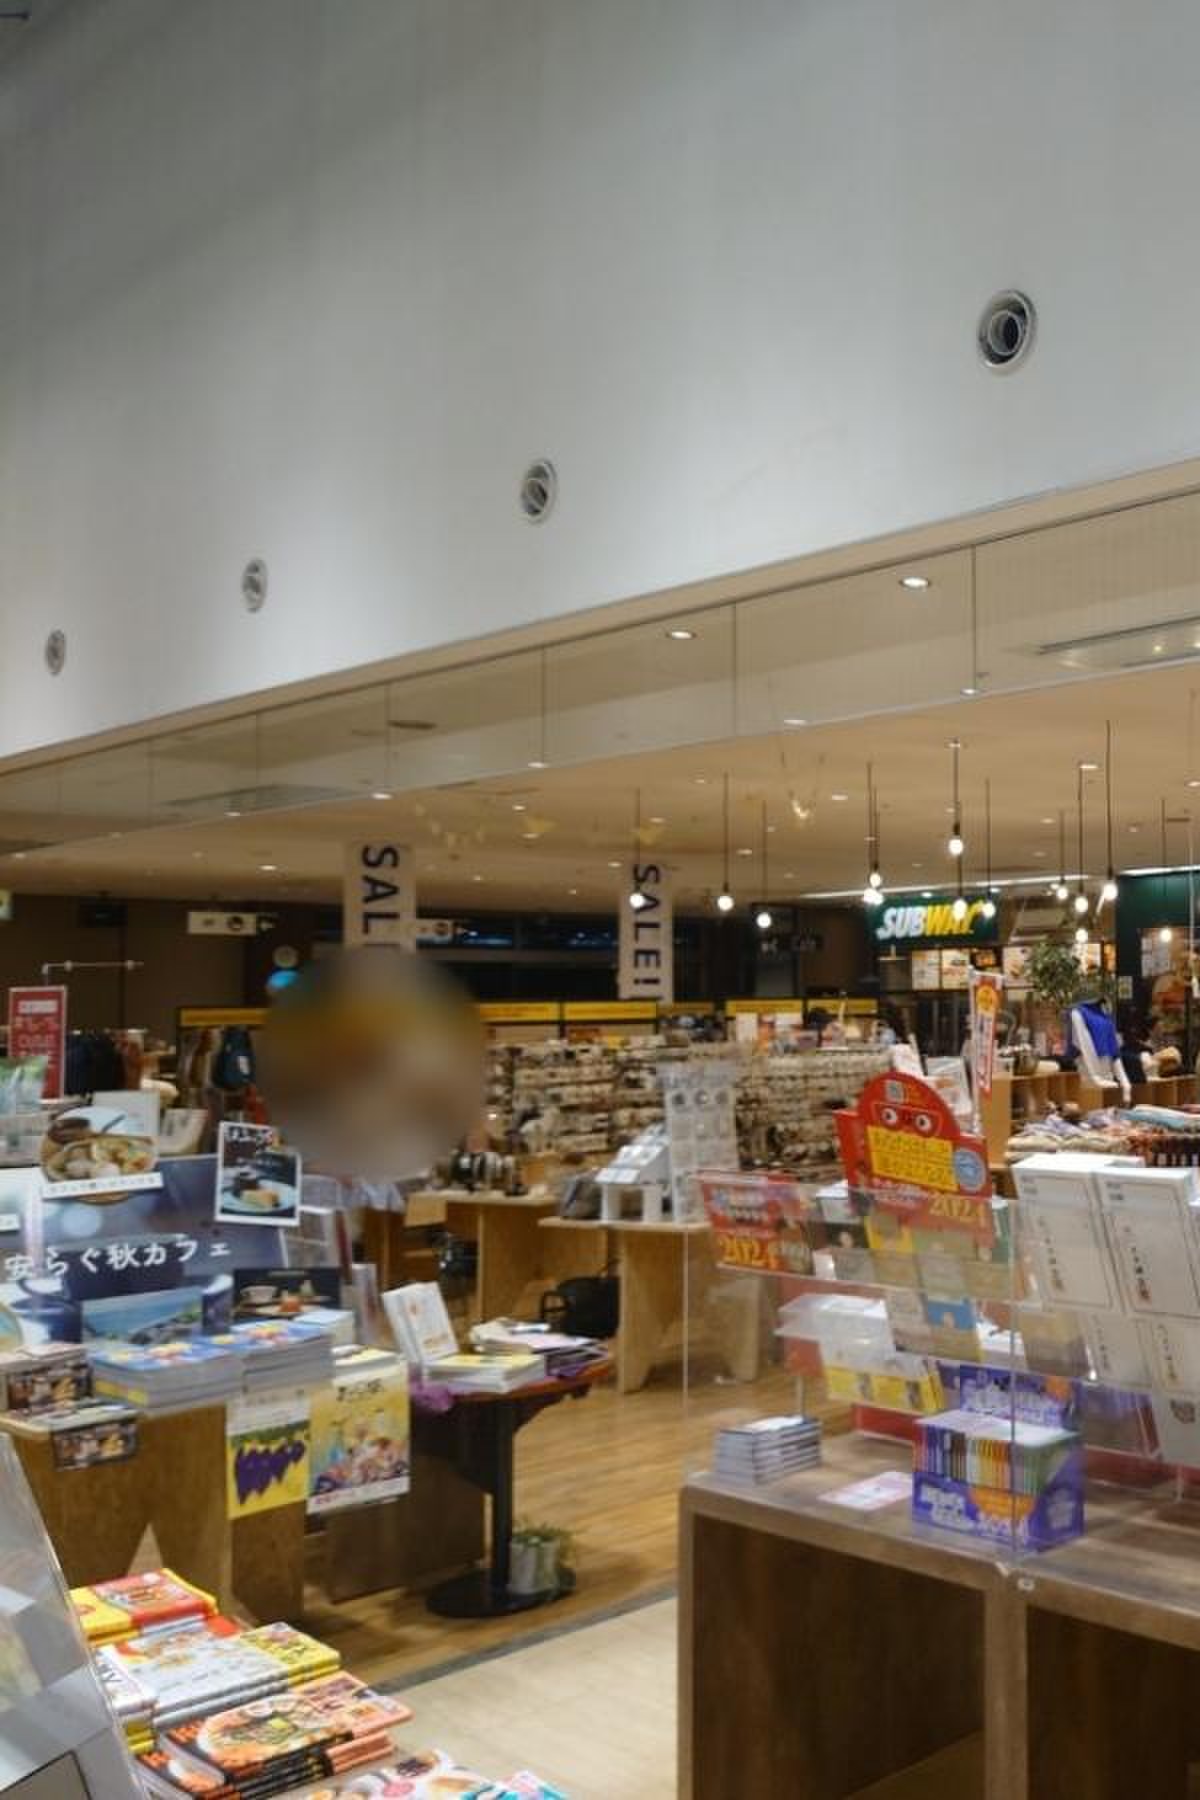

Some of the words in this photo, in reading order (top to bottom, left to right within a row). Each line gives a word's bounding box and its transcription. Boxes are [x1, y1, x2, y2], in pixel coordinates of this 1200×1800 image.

[361, 844, 401, 947] SAL
[632, 863, 661, 985] SALE!
[876, 901, 985, 939] SUBWAY
[4, 1239, 232, 1281] 安らぐ秋カフェ
